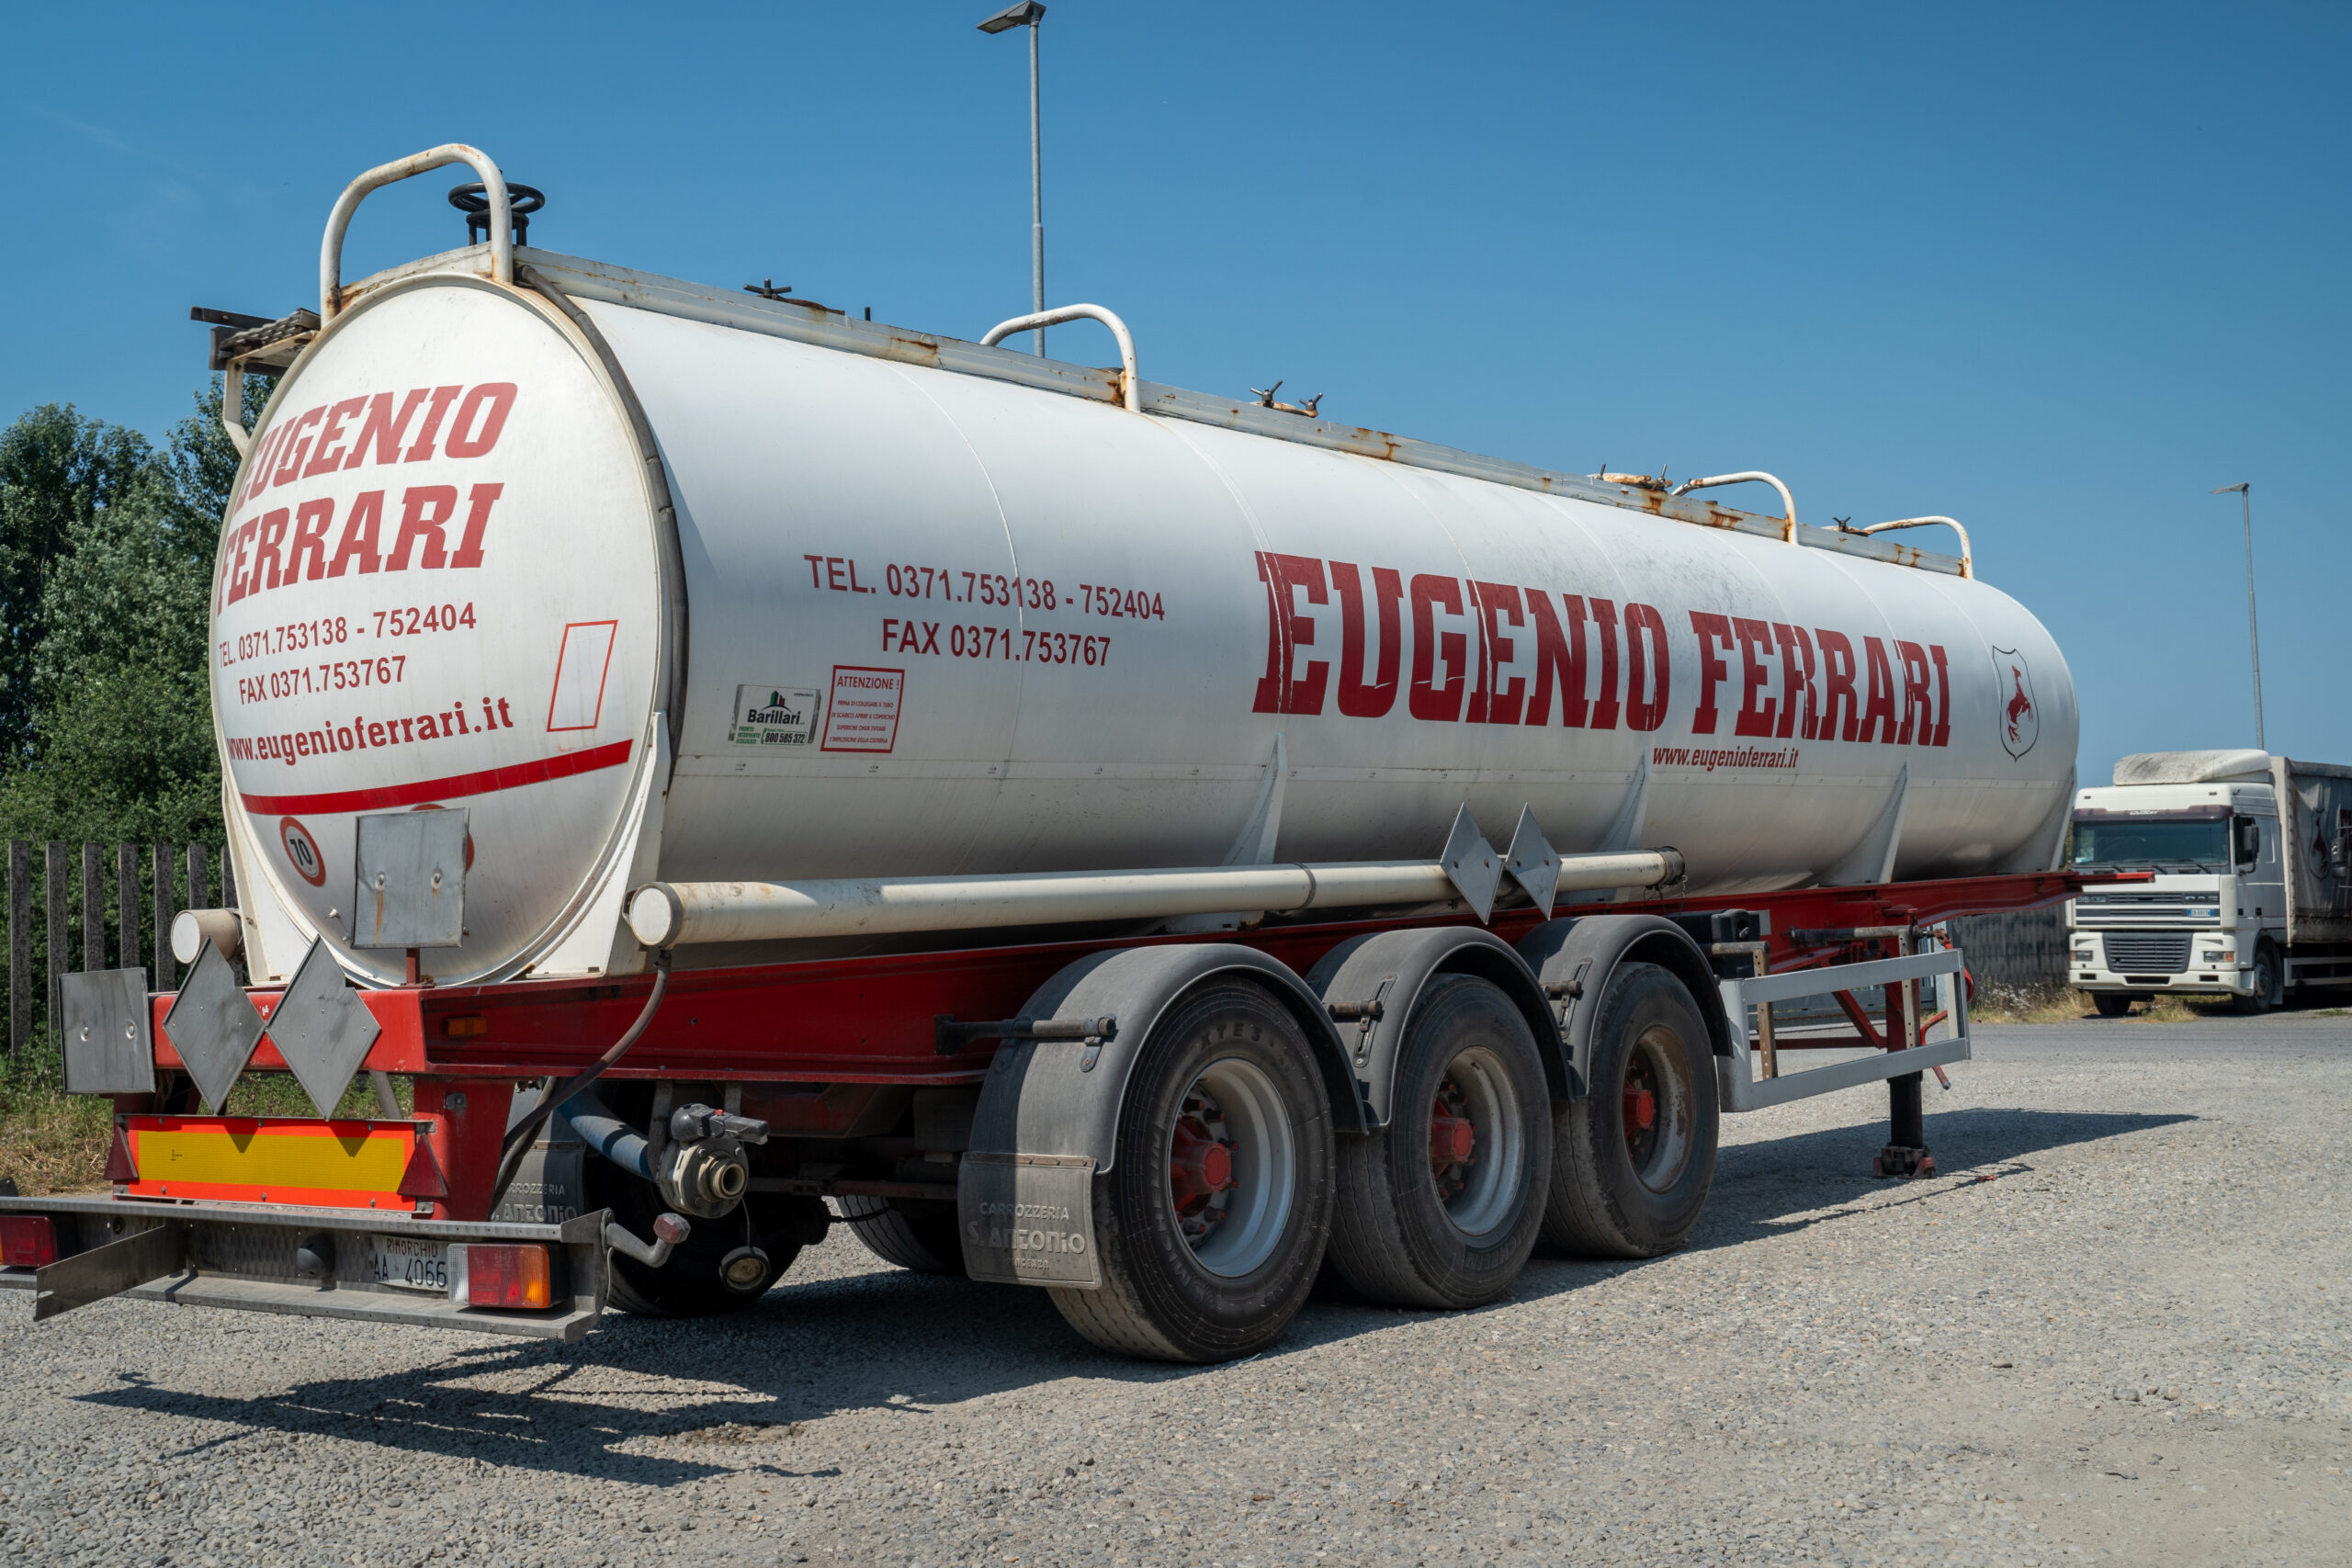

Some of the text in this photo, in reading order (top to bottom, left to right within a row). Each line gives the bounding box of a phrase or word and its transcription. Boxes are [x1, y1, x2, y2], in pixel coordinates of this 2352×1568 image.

[234, 382, 518, 515] EUGENIO
[217, 482, 504, 617] FERRARI
[804, 555, 876, 593] TEL.
[887, 564, 1057, 610] 0371.753138
[1080, 584, 1165, 620] 752404
[220, 640, 236, 669] TEL.
[239, 616, 347, 660] 0371.753138
[373, 603, 477, 638] 752404
[882, 619, 1111, 666] FAX 0371.753767
[1253, 550, 1951, 747] EUGENIO FERRARI
[239, 655, 406, 705] FAX 0371.753767
[836, 675, 894, 690] ATTENZIONE
[227, 696, 514, 766] www.eugenioferrari.it
[747, 708, 801, 725] Barillari
[764, 732, 778, 743] 800
[793, 734, 806, 743] 372
[1653, 745, 1799, 773] www.eugenioferrari.it
[288, 838, 313, 866] 70
[506, 1182, 566, 1196] RROZZERIA
[978, 1201, 1070, 1221] CARROZZERIA
[386, 1238, 438, 1258] RIMORCHIO
[373, 1251, 390, 1283] AA
